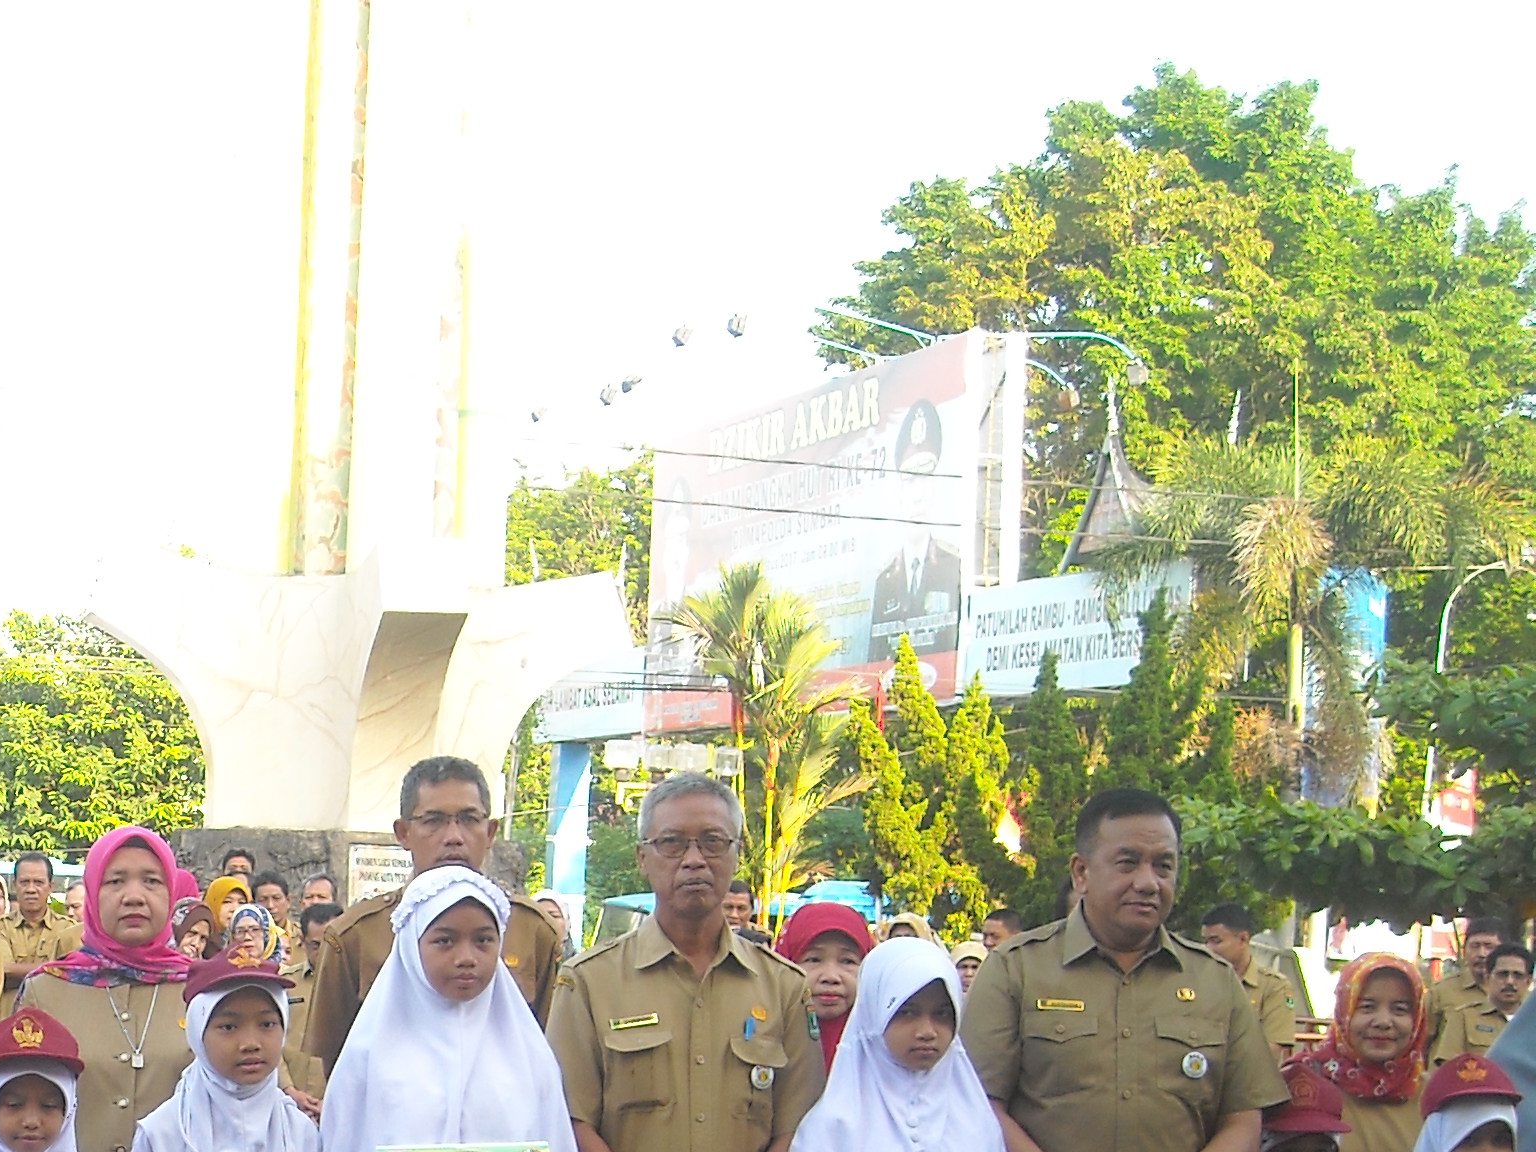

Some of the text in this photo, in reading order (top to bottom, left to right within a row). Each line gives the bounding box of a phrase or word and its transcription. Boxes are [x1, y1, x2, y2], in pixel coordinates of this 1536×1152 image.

[707, 377, 880, 475] DZIKIR AKBAR
[798, 463, 824, 502] HUT
[746, 515, 793, 547] MAPOLDA
[797, 503, 841, 535] SUMBAR
[975, 607, 1028, 639] PATUHILAH
[1030, 602, 1065, 631] RAMBU
[1073, 590, 1107, 626] RAMB
[986, 645, 1009, 672] DEMI
[1085, 633, 1109, 661] KITA
[1111, 628, 1143, 658] BERS
